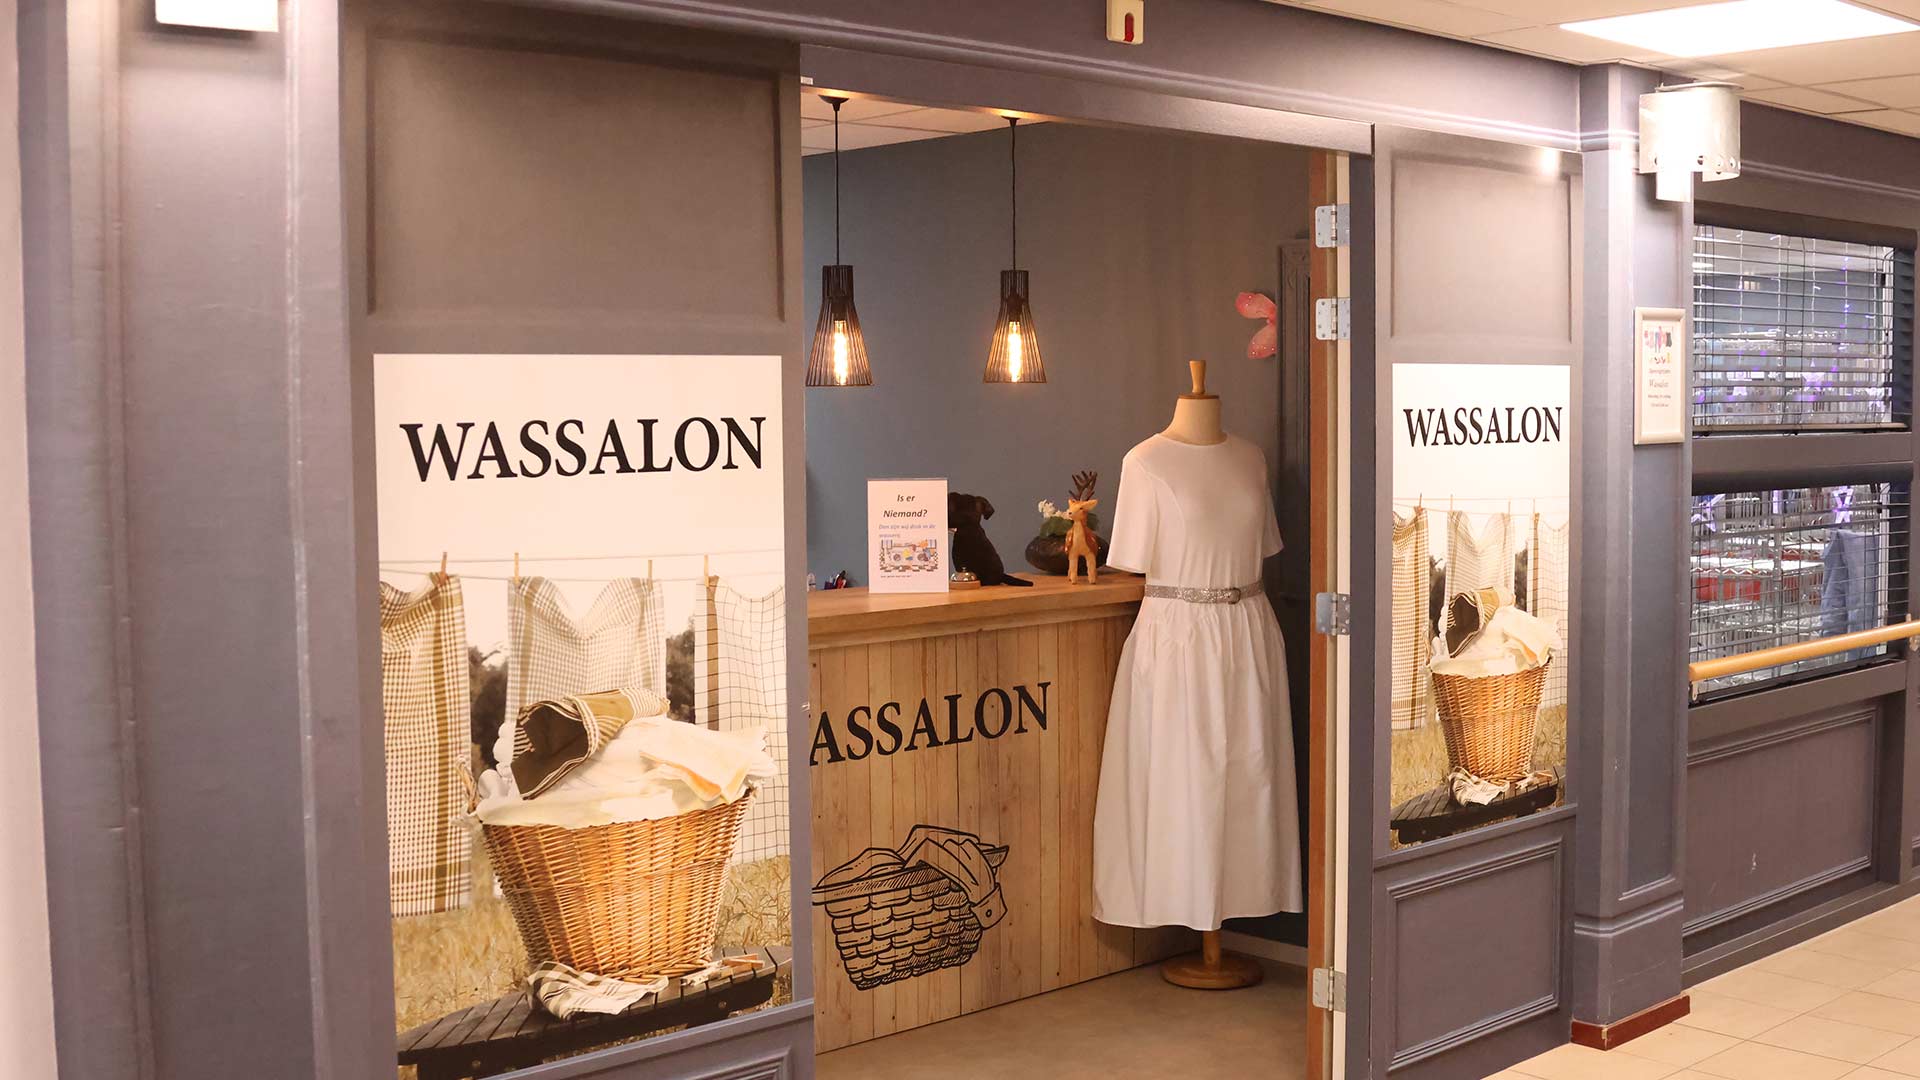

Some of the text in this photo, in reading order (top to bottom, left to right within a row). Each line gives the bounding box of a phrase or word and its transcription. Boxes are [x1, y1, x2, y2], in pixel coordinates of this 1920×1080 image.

[1402, 406, 1563, 447] WASSALON
[399, 416, 767, 482] WASSALON
[883, 509, 928, 518] Niemand?
[897, 494, 904, 502] Is
[809, 681, 1051, 766] ASSALON
